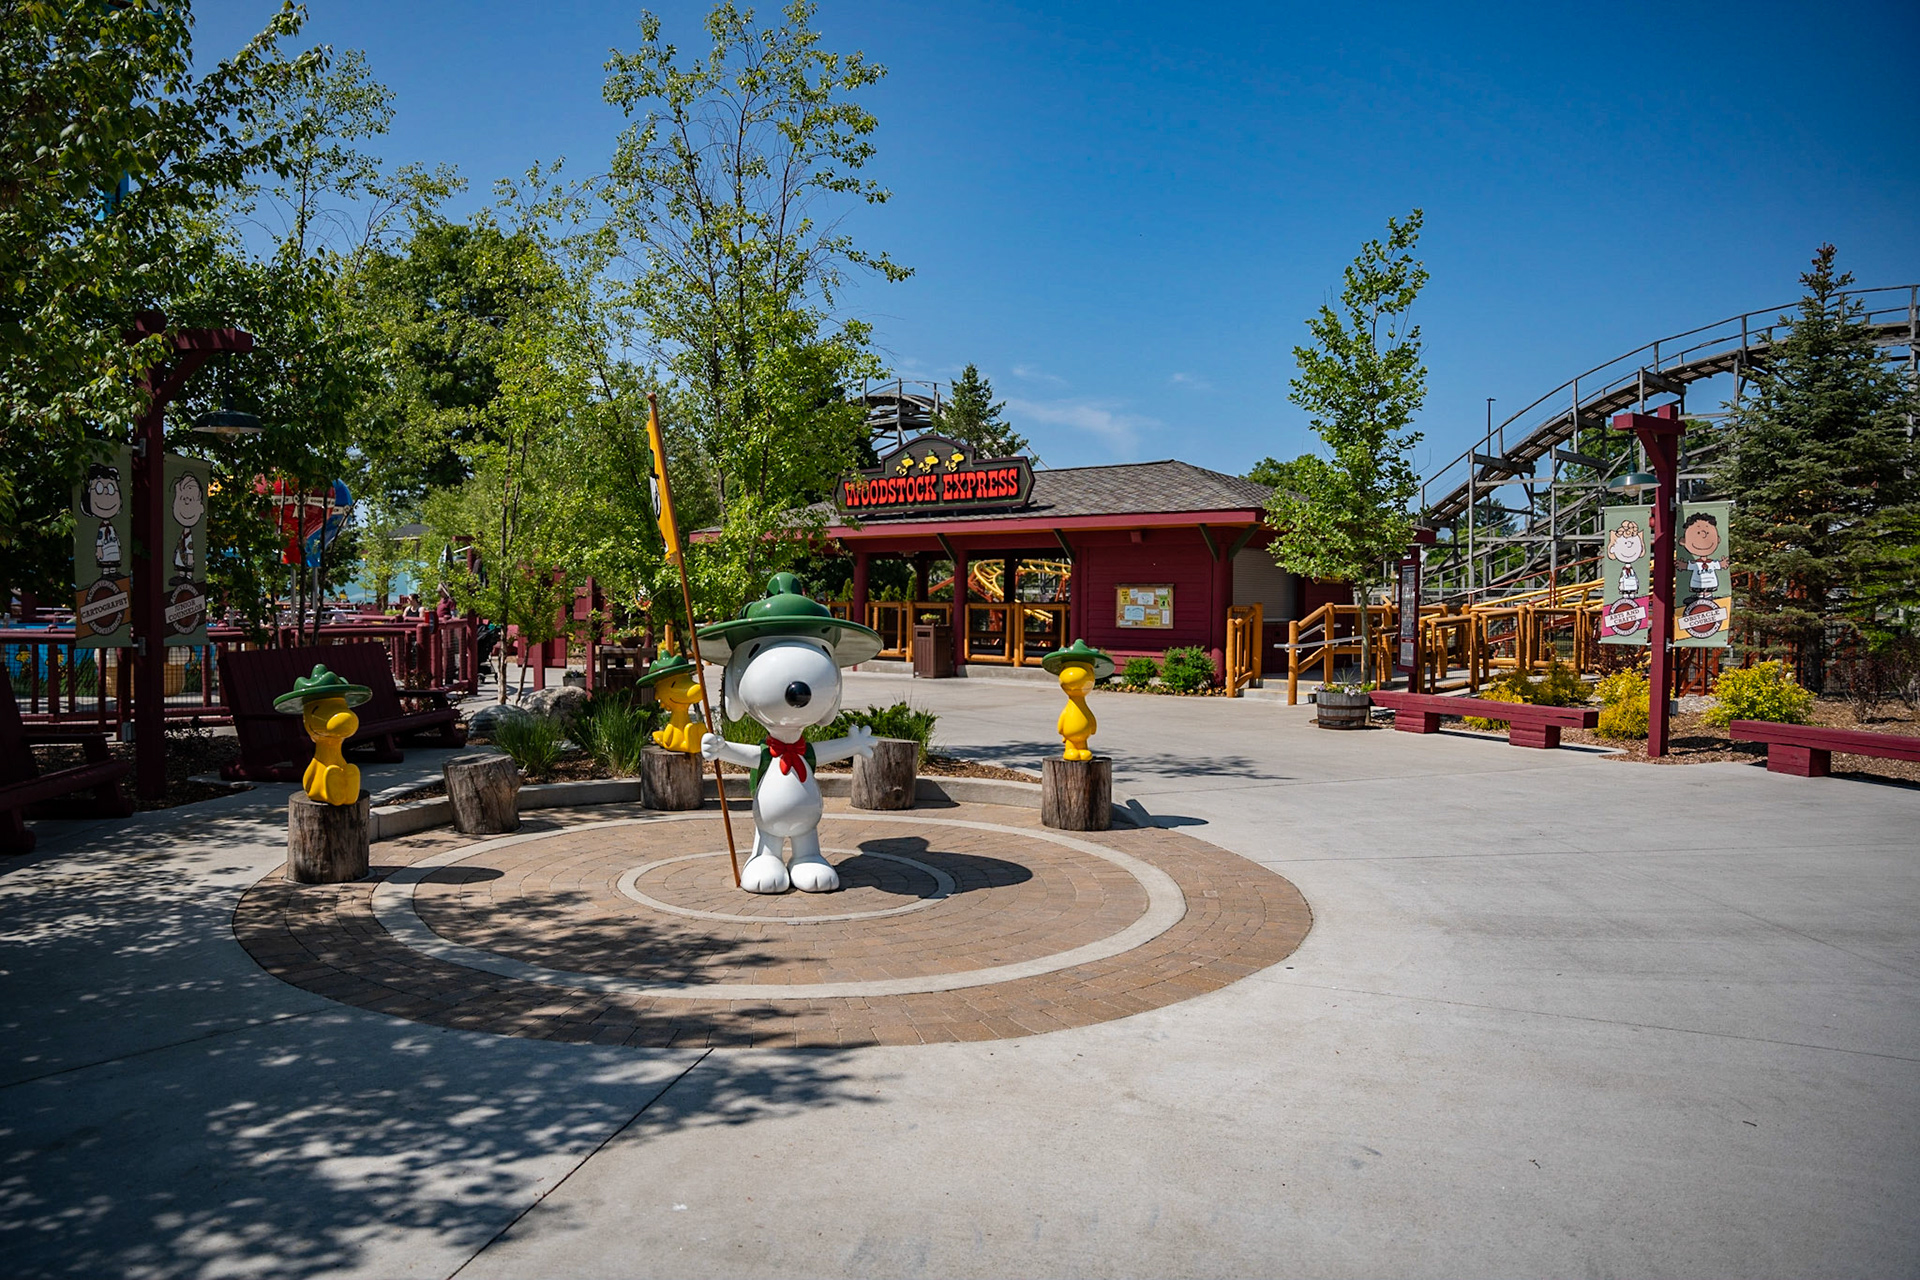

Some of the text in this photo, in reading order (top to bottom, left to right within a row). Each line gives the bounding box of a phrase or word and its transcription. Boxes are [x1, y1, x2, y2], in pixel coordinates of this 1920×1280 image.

[844, 468, 1018, 506] WOODSTOCK EXPRESS
[81, 597, 128, 619] CARTOGRAPHY
[174, 599, 196, 612] JUNIOR
[168, 604, 202, 621] COUNSELOR
[1610, 613, 1624, 621] ARTS
[1683, 610, 1721, 622] OBSTACLE
[1613, 615, 1637, 624] CRAFTS
[1689, 616, 1717, 626] COURSE
